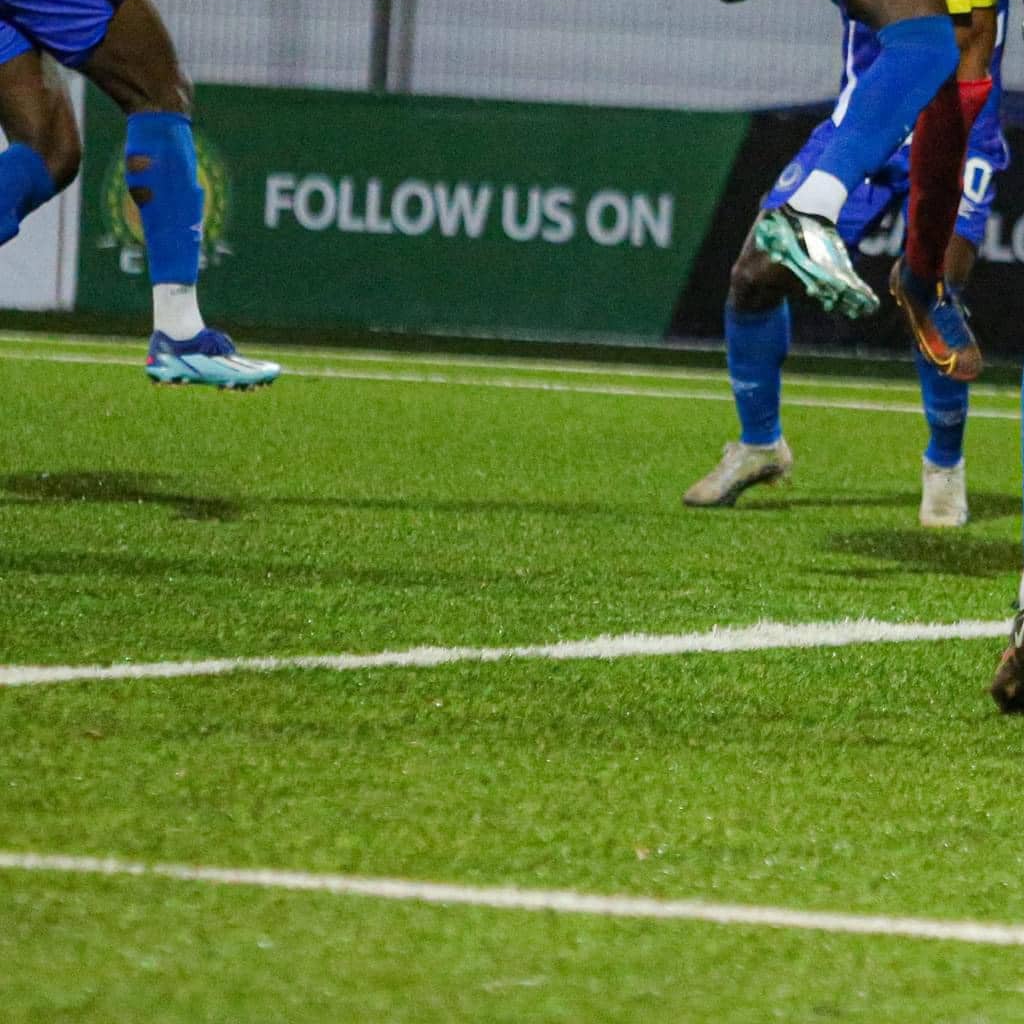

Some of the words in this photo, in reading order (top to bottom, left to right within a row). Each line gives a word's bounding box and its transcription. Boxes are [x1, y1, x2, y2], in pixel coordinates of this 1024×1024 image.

[264, 173, 491, 238] FOLLOW
[502, 185, 576, 243] US
[586, 190, 673, 248] ON
